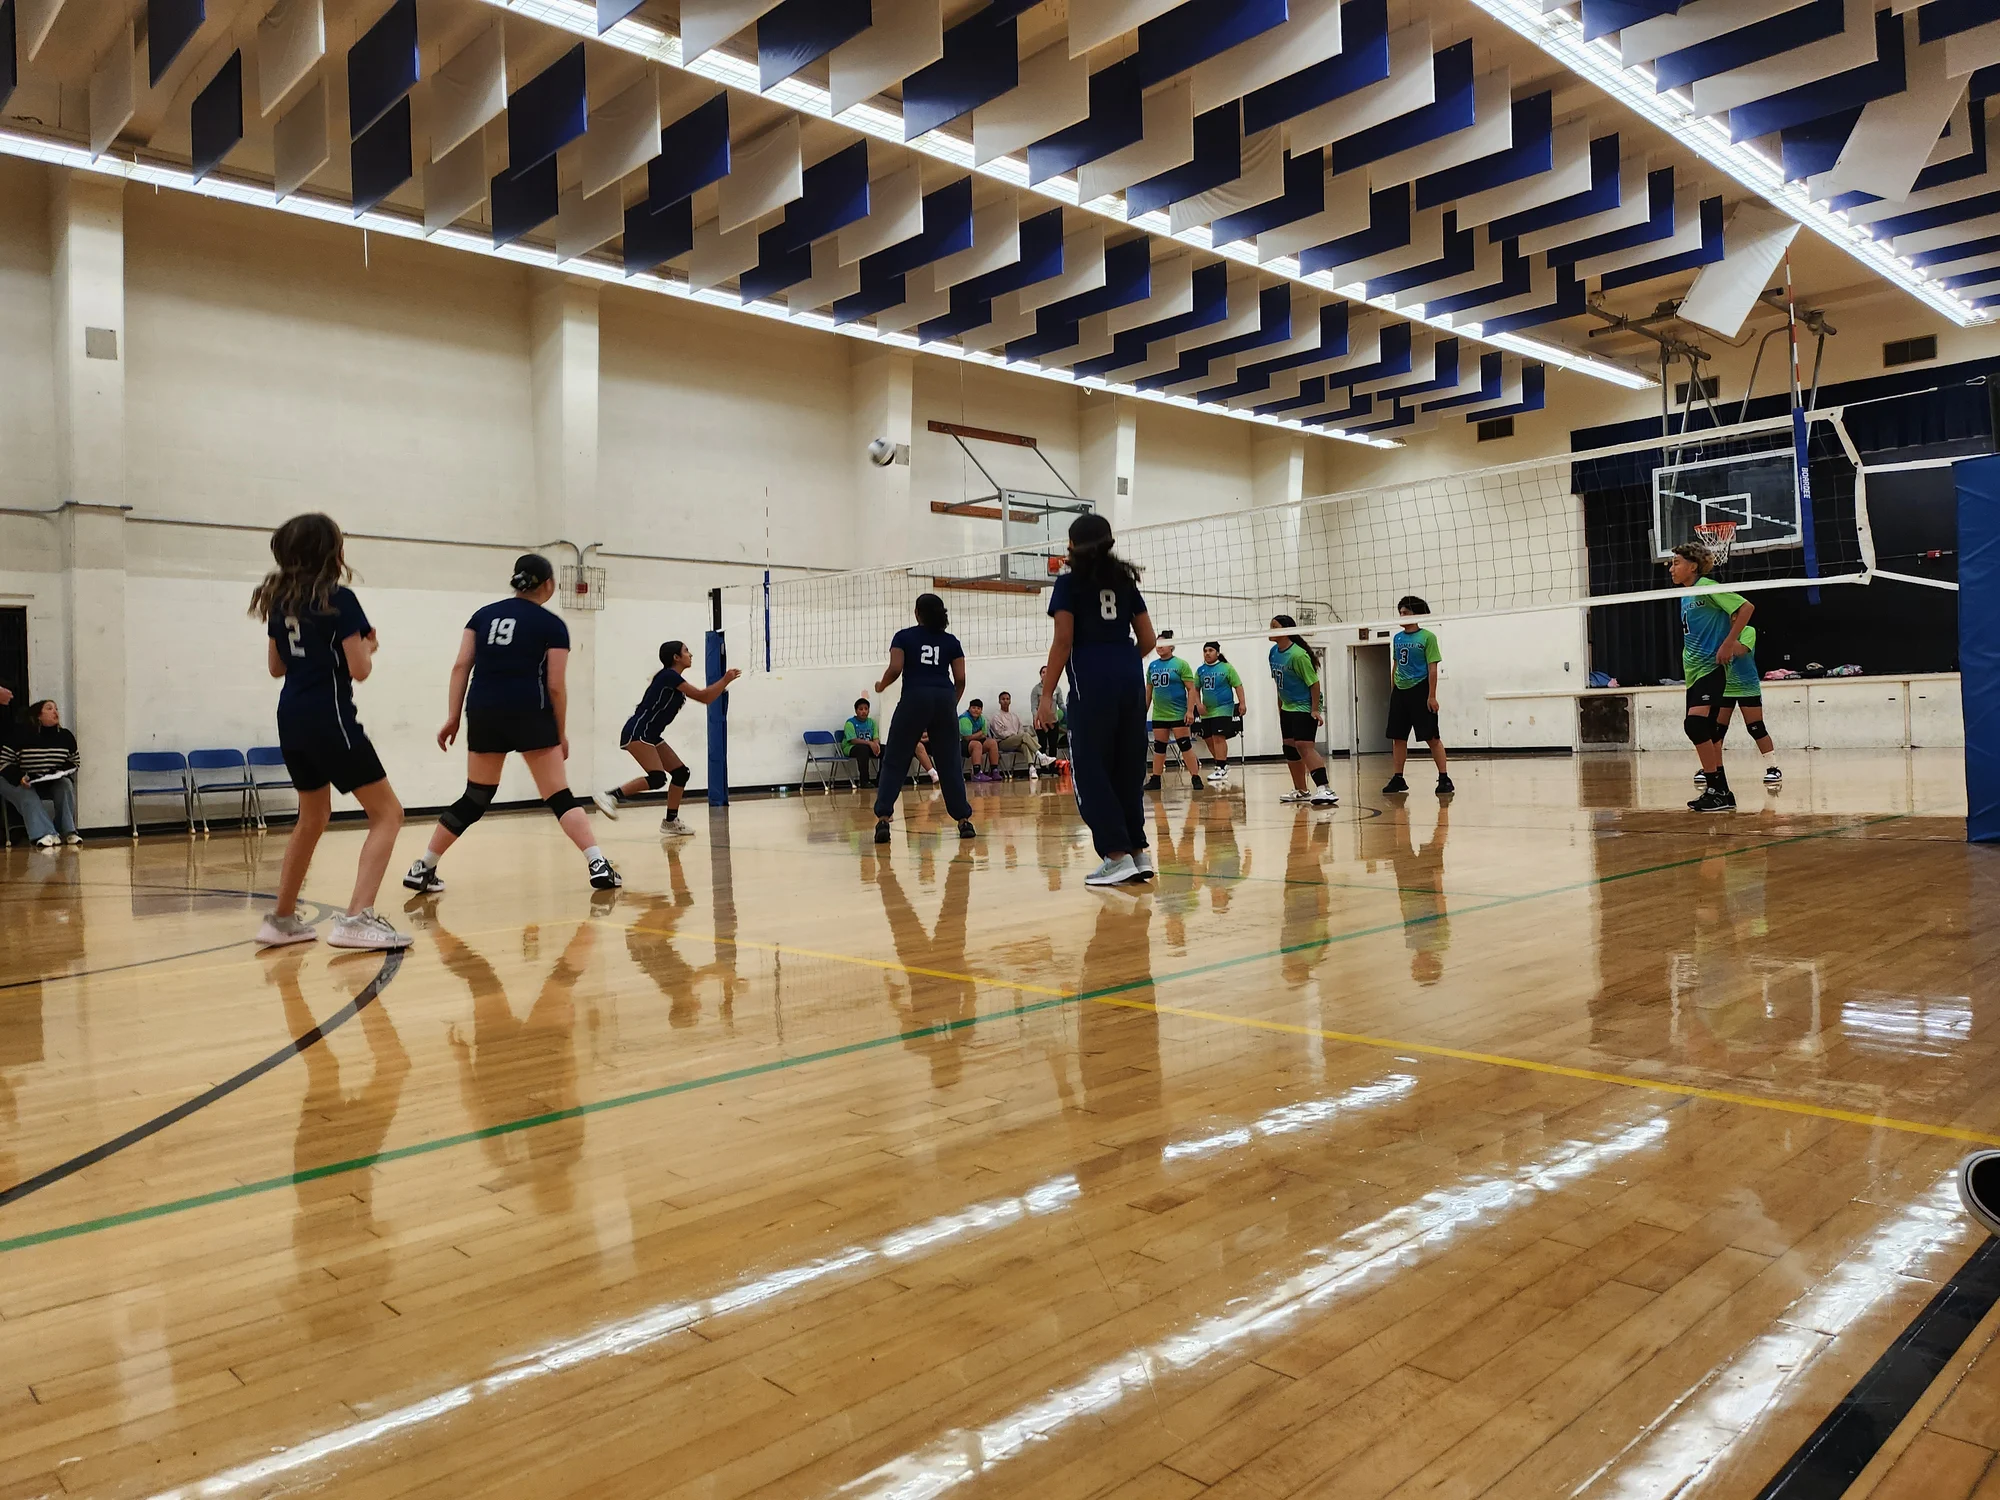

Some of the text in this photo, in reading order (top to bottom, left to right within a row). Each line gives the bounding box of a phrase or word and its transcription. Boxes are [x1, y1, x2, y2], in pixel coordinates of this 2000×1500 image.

[1100, 589, 1117, 621] 8
[284, 615, 306, 657] 2
[487, 617, 517, 646] 19
[920, 644, 940, 666] 21
[1399, 647, 1410, 666] 3
[1151, 671, 1171, 688] 20
[1203, 675, 1217, 691] 21
[335, 925, 387, 943] adidas
